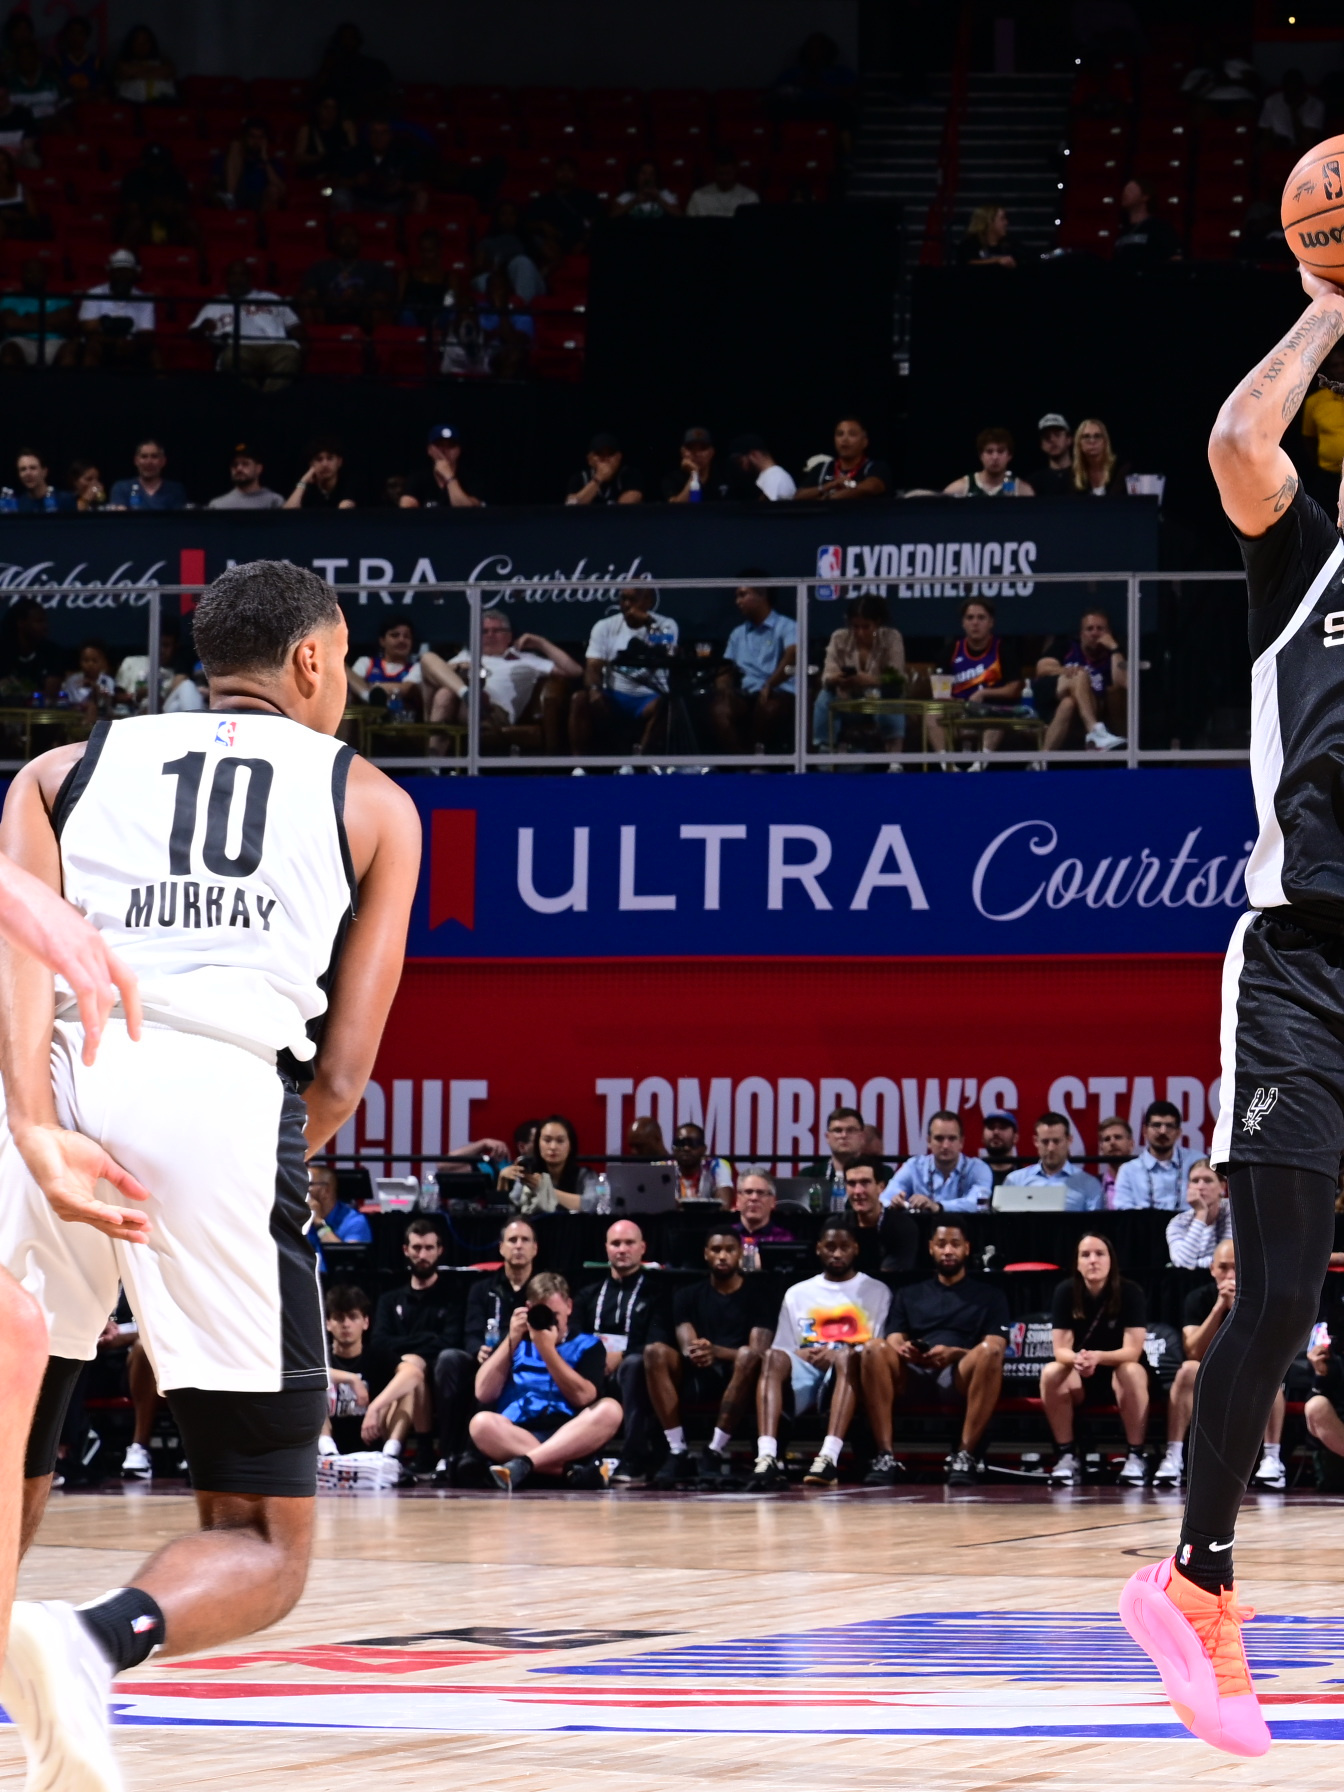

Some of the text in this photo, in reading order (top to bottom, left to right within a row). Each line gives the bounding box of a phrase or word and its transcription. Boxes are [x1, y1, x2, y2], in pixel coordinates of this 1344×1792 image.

[1263, 357, 1286, 382] XXV
[845, 541, 1037, 599] EXPERIENCES
[161, 750, 275, 878] 10
[517, 819, 1252, 921] ULTRA Courtsi
[125, 881, 277, 932] MURRAY
